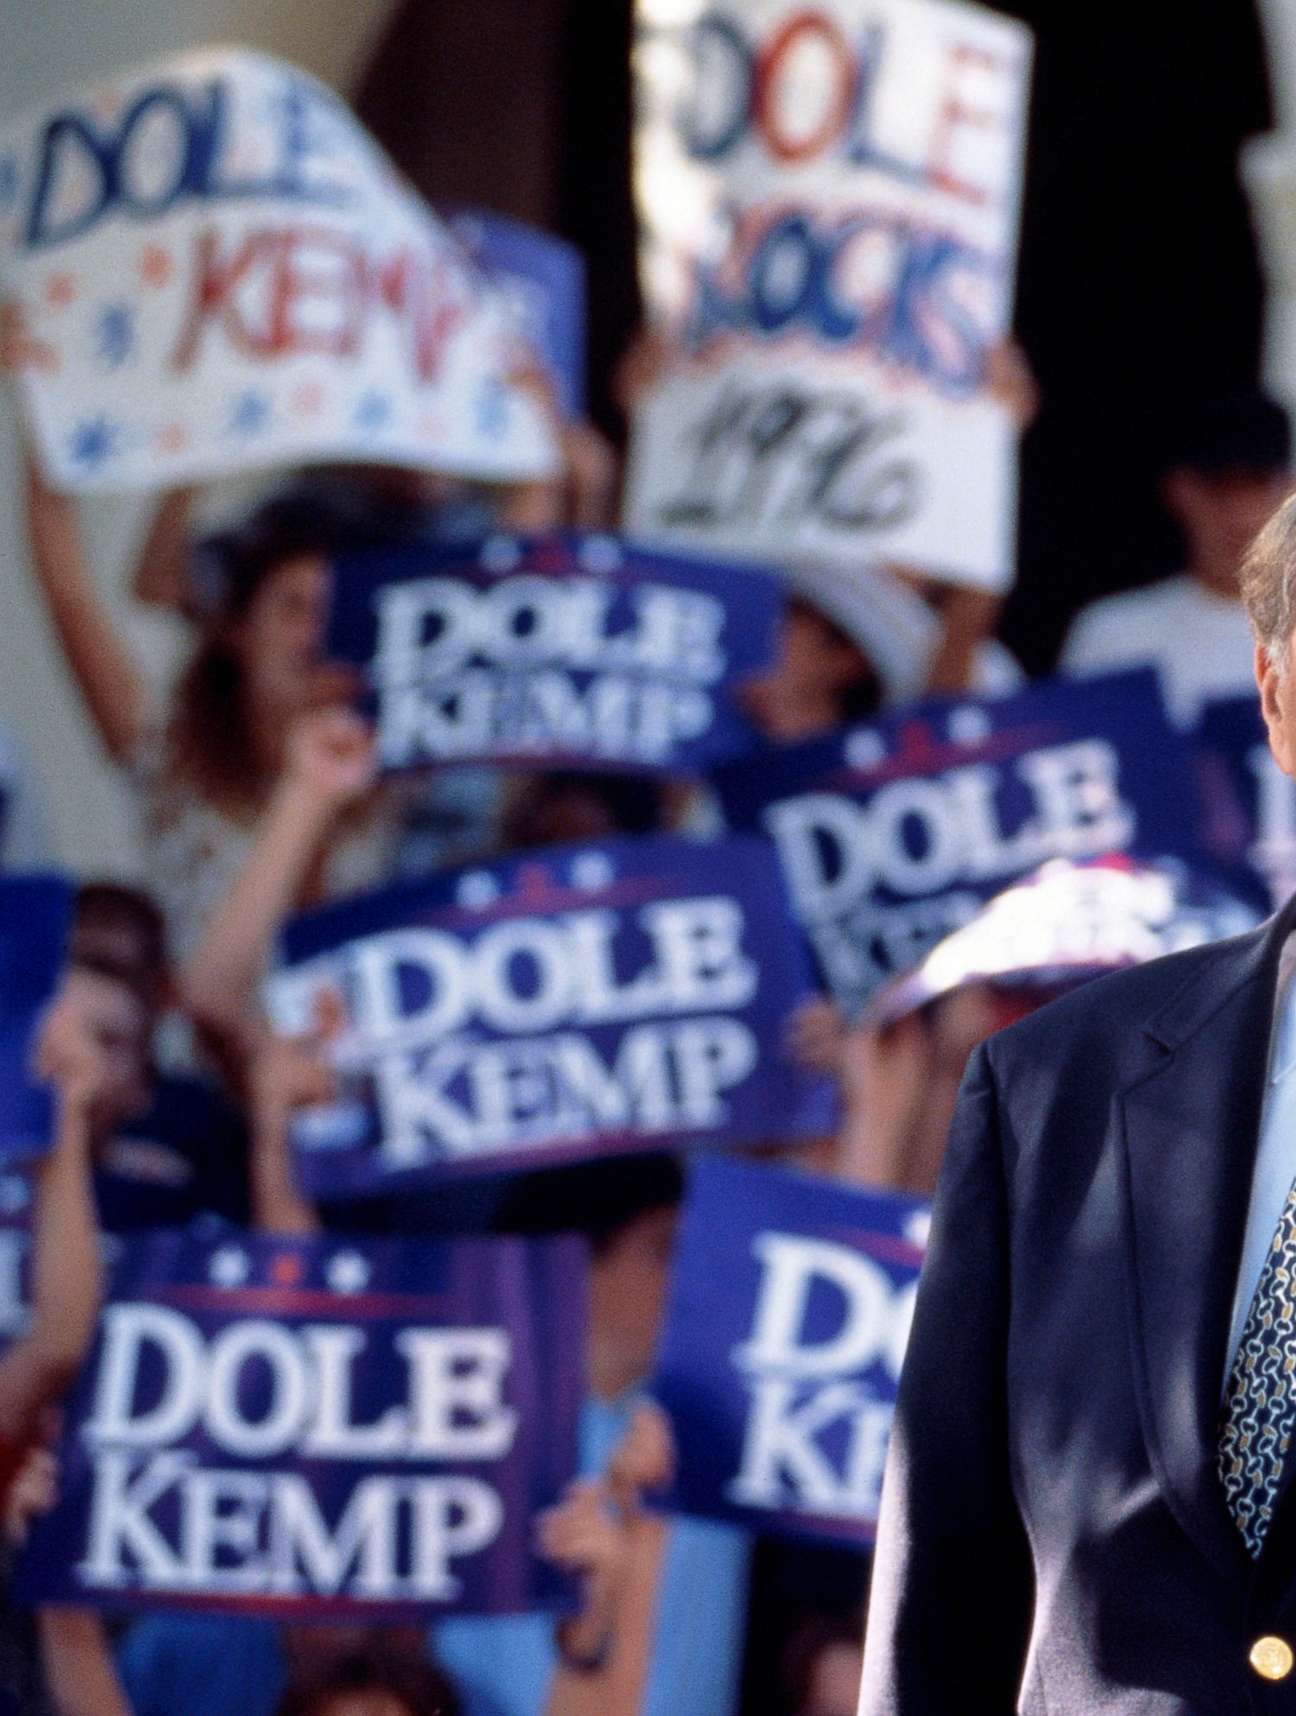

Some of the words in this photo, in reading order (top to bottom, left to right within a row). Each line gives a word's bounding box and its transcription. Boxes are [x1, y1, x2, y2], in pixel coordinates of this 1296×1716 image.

[22, 75, 352, 256] DOLE
[372, 572, 728, 686] DOLE
[762, 736, 1138, 908] DOLE
[340, 893, 760, 1058] DOLE
[374, 1012, 760, 1172] KEMP
[80, 1301, 520, 1462] DOLE
[76, 1446, 506, 1602] KEMP
